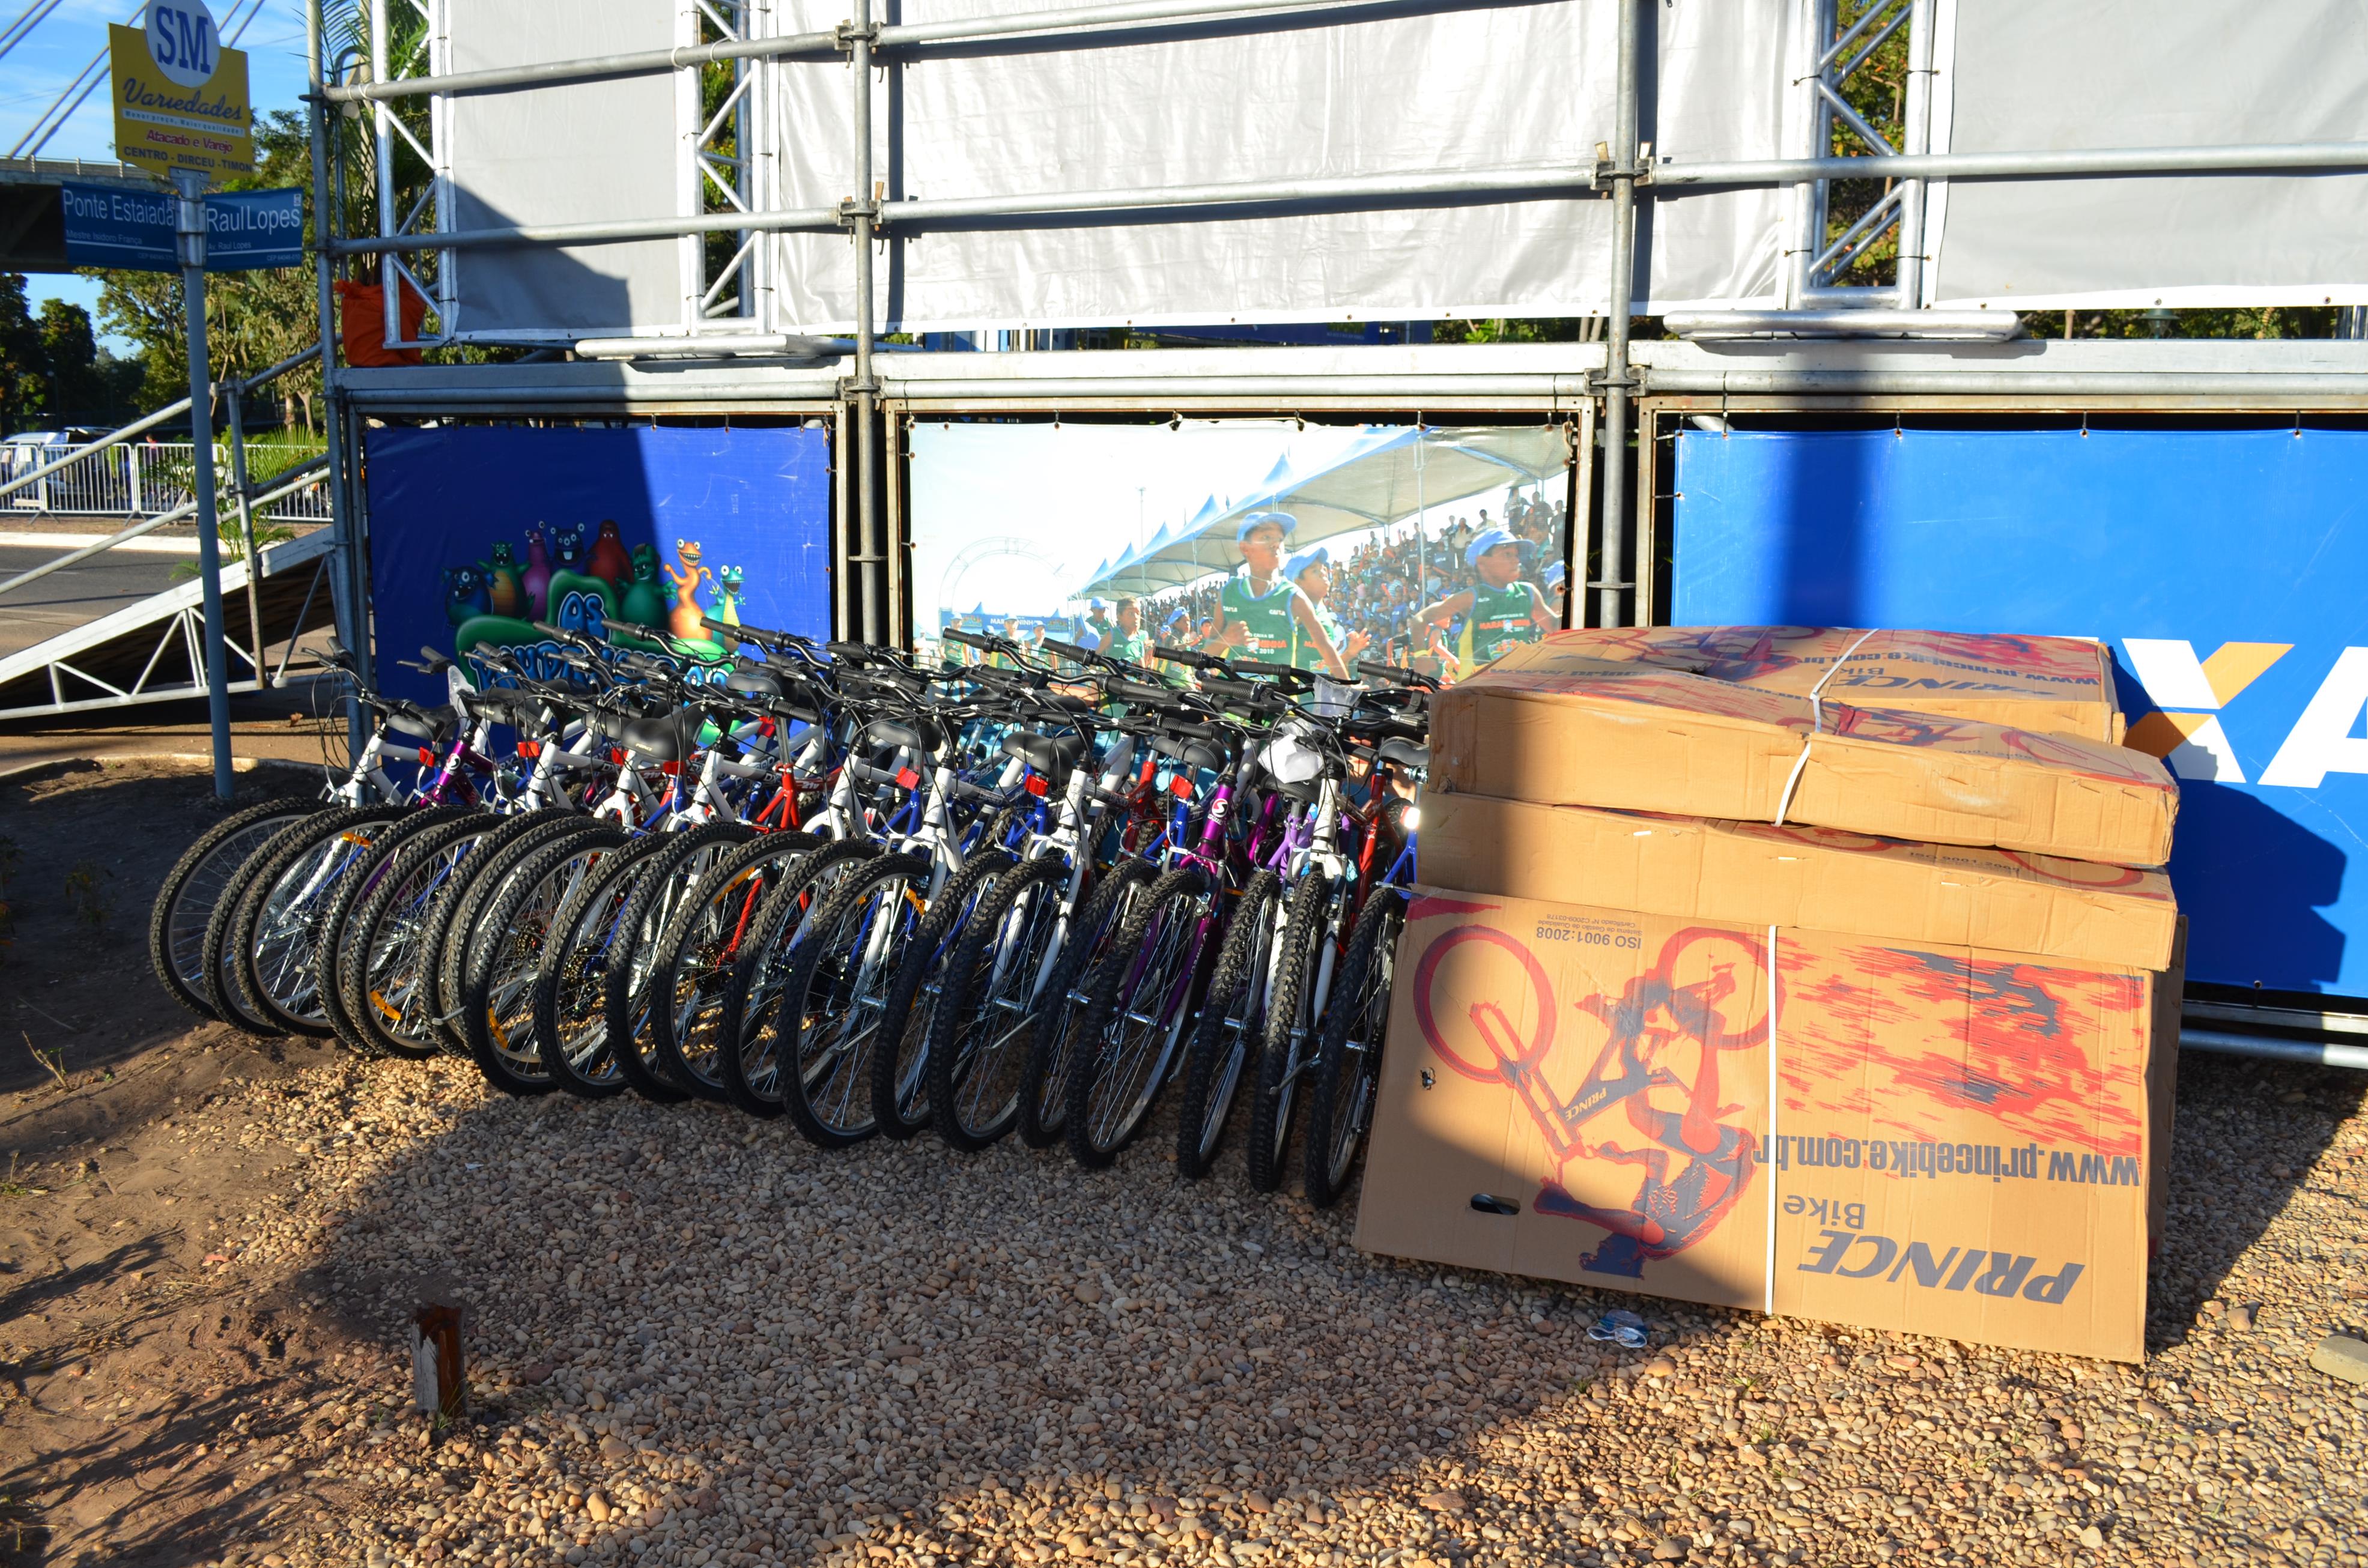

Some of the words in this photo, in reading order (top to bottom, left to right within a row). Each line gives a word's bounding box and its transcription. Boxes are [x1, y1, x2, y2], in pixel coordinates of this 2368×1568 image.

[156, 5, 211, 74] SM
[123, 78, 243, 120] Variedades
[146, 129, 190, 147] Atacado
[192, 139, 200, 148] e
[203, 137, 234, 154] Varejo
[124, 146, 168, 161] CENTRO
[177, 154, 215, 168] DIRCEU
[62, 189, 108, 220] Ponte
[112, 195, 175, 226] Estaiada
[206, 206, 244, 233] Raul
[247, 205, 300, 235] Lopes
[65, 229, 91, 240] Mestre
[118, 234, 143, 245] França
[218, 241, 232, 250] Raul
[233, 241, 252, 250] Lopes
[1537, 919, 1570, 928] Qualidade
[1582, 924, 1605, 932] Gestão
[1601, 919, 1636, 928] Certificado
[1617, 927, 1643, 936] Sistema
[1536, 927, 1611, 946] 9001:2008
[1615, 935, 1642, 949] ISO
[1565, 1086, 1607, 1122] PRINCE
[1753, 1134, 2140, 1187] www.princebike.com.br
[1783, 1194, 1866, 1229] Bike
[1796, 1229, 2086, 1305] PRINCE
